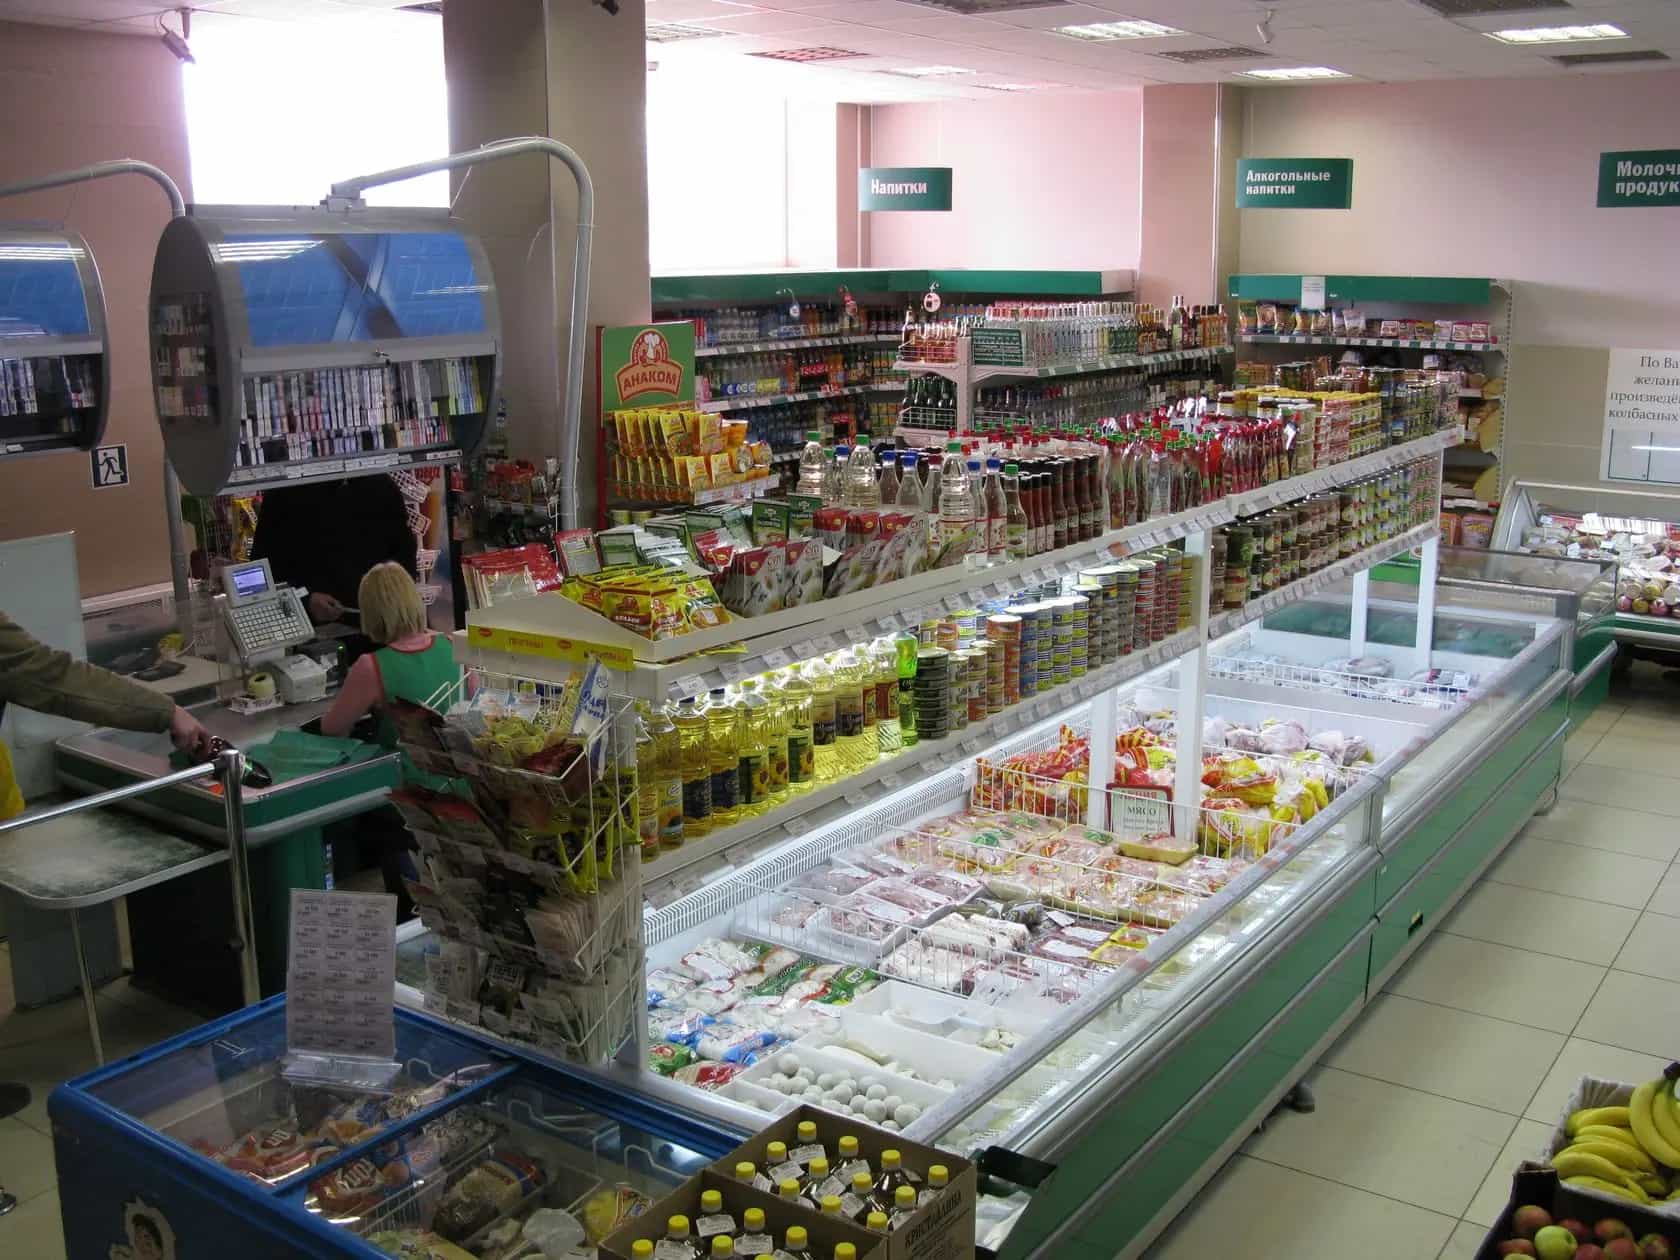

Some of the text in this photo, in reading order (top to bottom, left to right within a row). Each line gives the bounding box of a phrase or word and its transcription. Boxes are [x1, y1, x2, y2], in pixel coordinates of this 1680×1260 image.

[1246, 170, 1331, 182] Алкогольные
[871, 178, 928, 195] Напитки
[1246, 185, 1296, 195] напитки
[1640, 356, 1661, 368] По
[623, 370, 678, 392] АНАКОМ
[1607, 407, 1680, 422] колбасных
